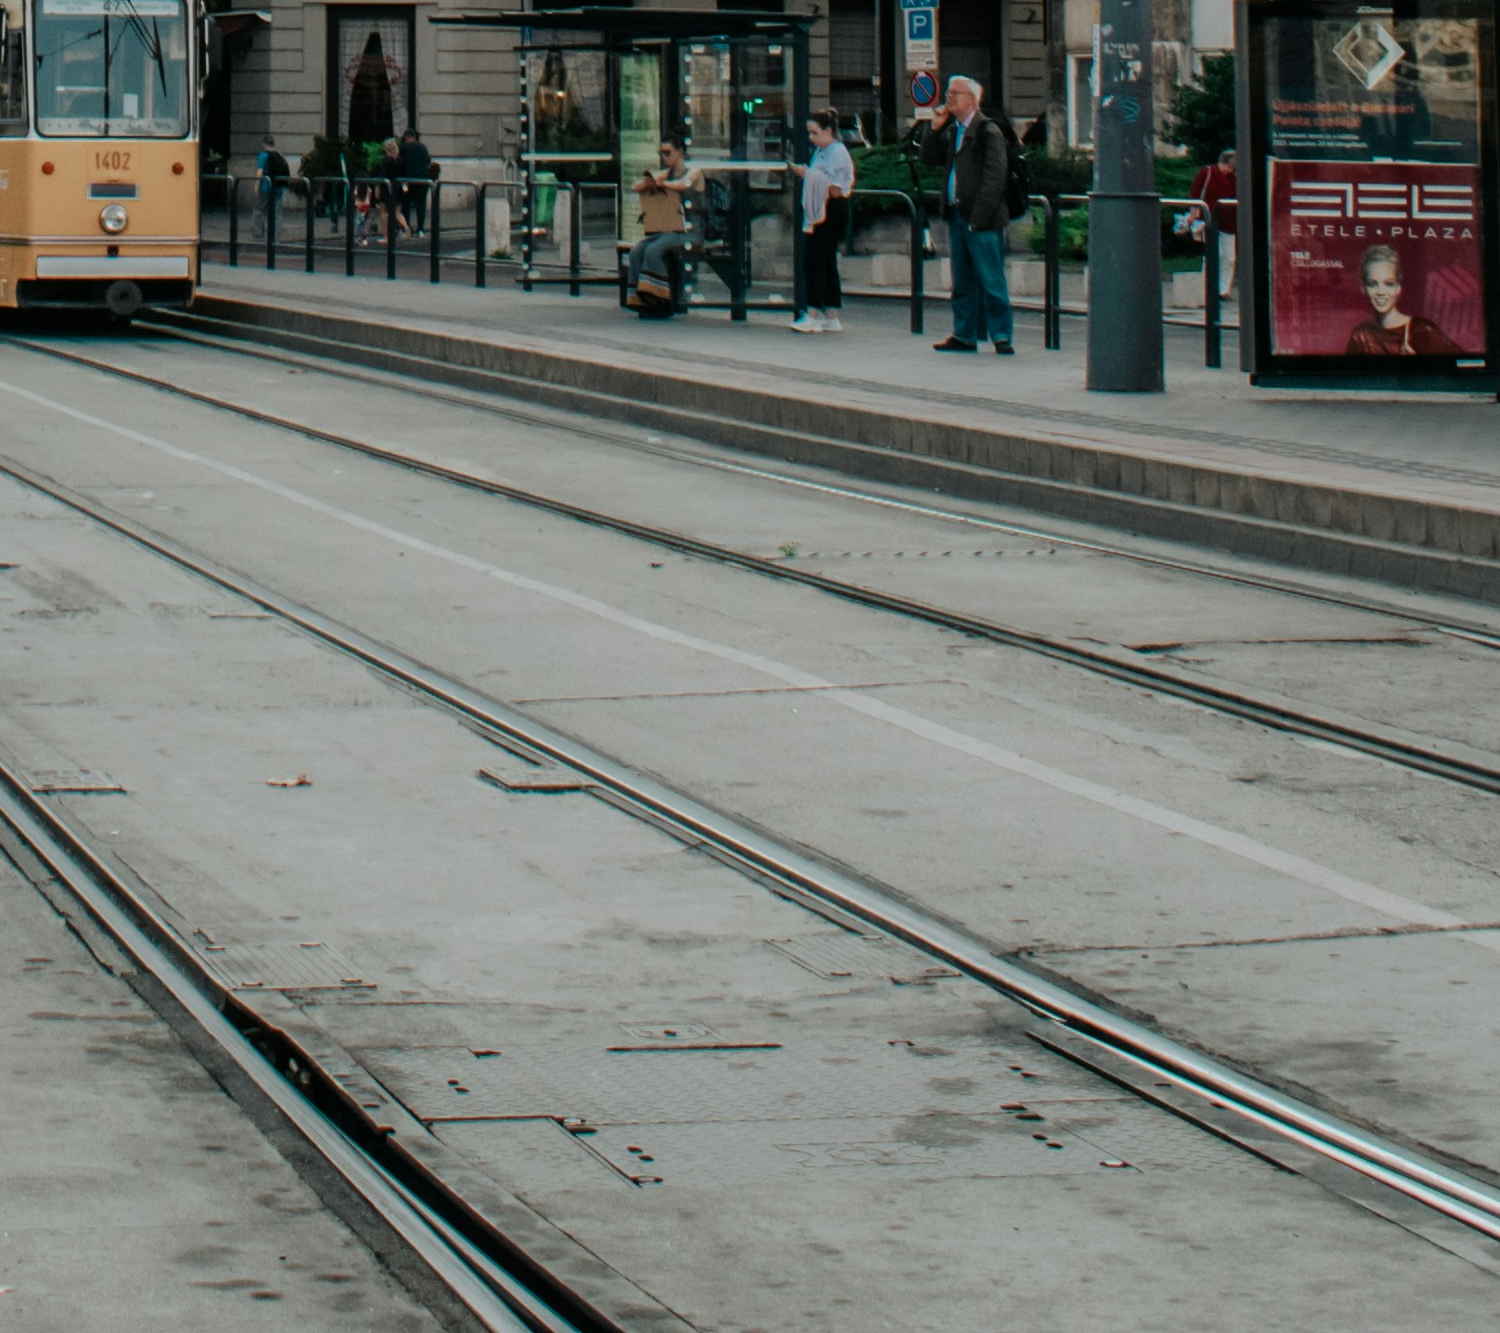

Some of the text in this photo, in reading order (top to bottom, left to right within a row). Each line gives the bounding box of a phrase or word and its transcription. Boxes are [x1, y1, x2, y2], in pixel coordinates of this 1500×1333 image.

[913, 16, 927, 34] P
[95, 151, 131, 171] 1402
[1291, 225, 1473, 239] ETELE PLAZA
